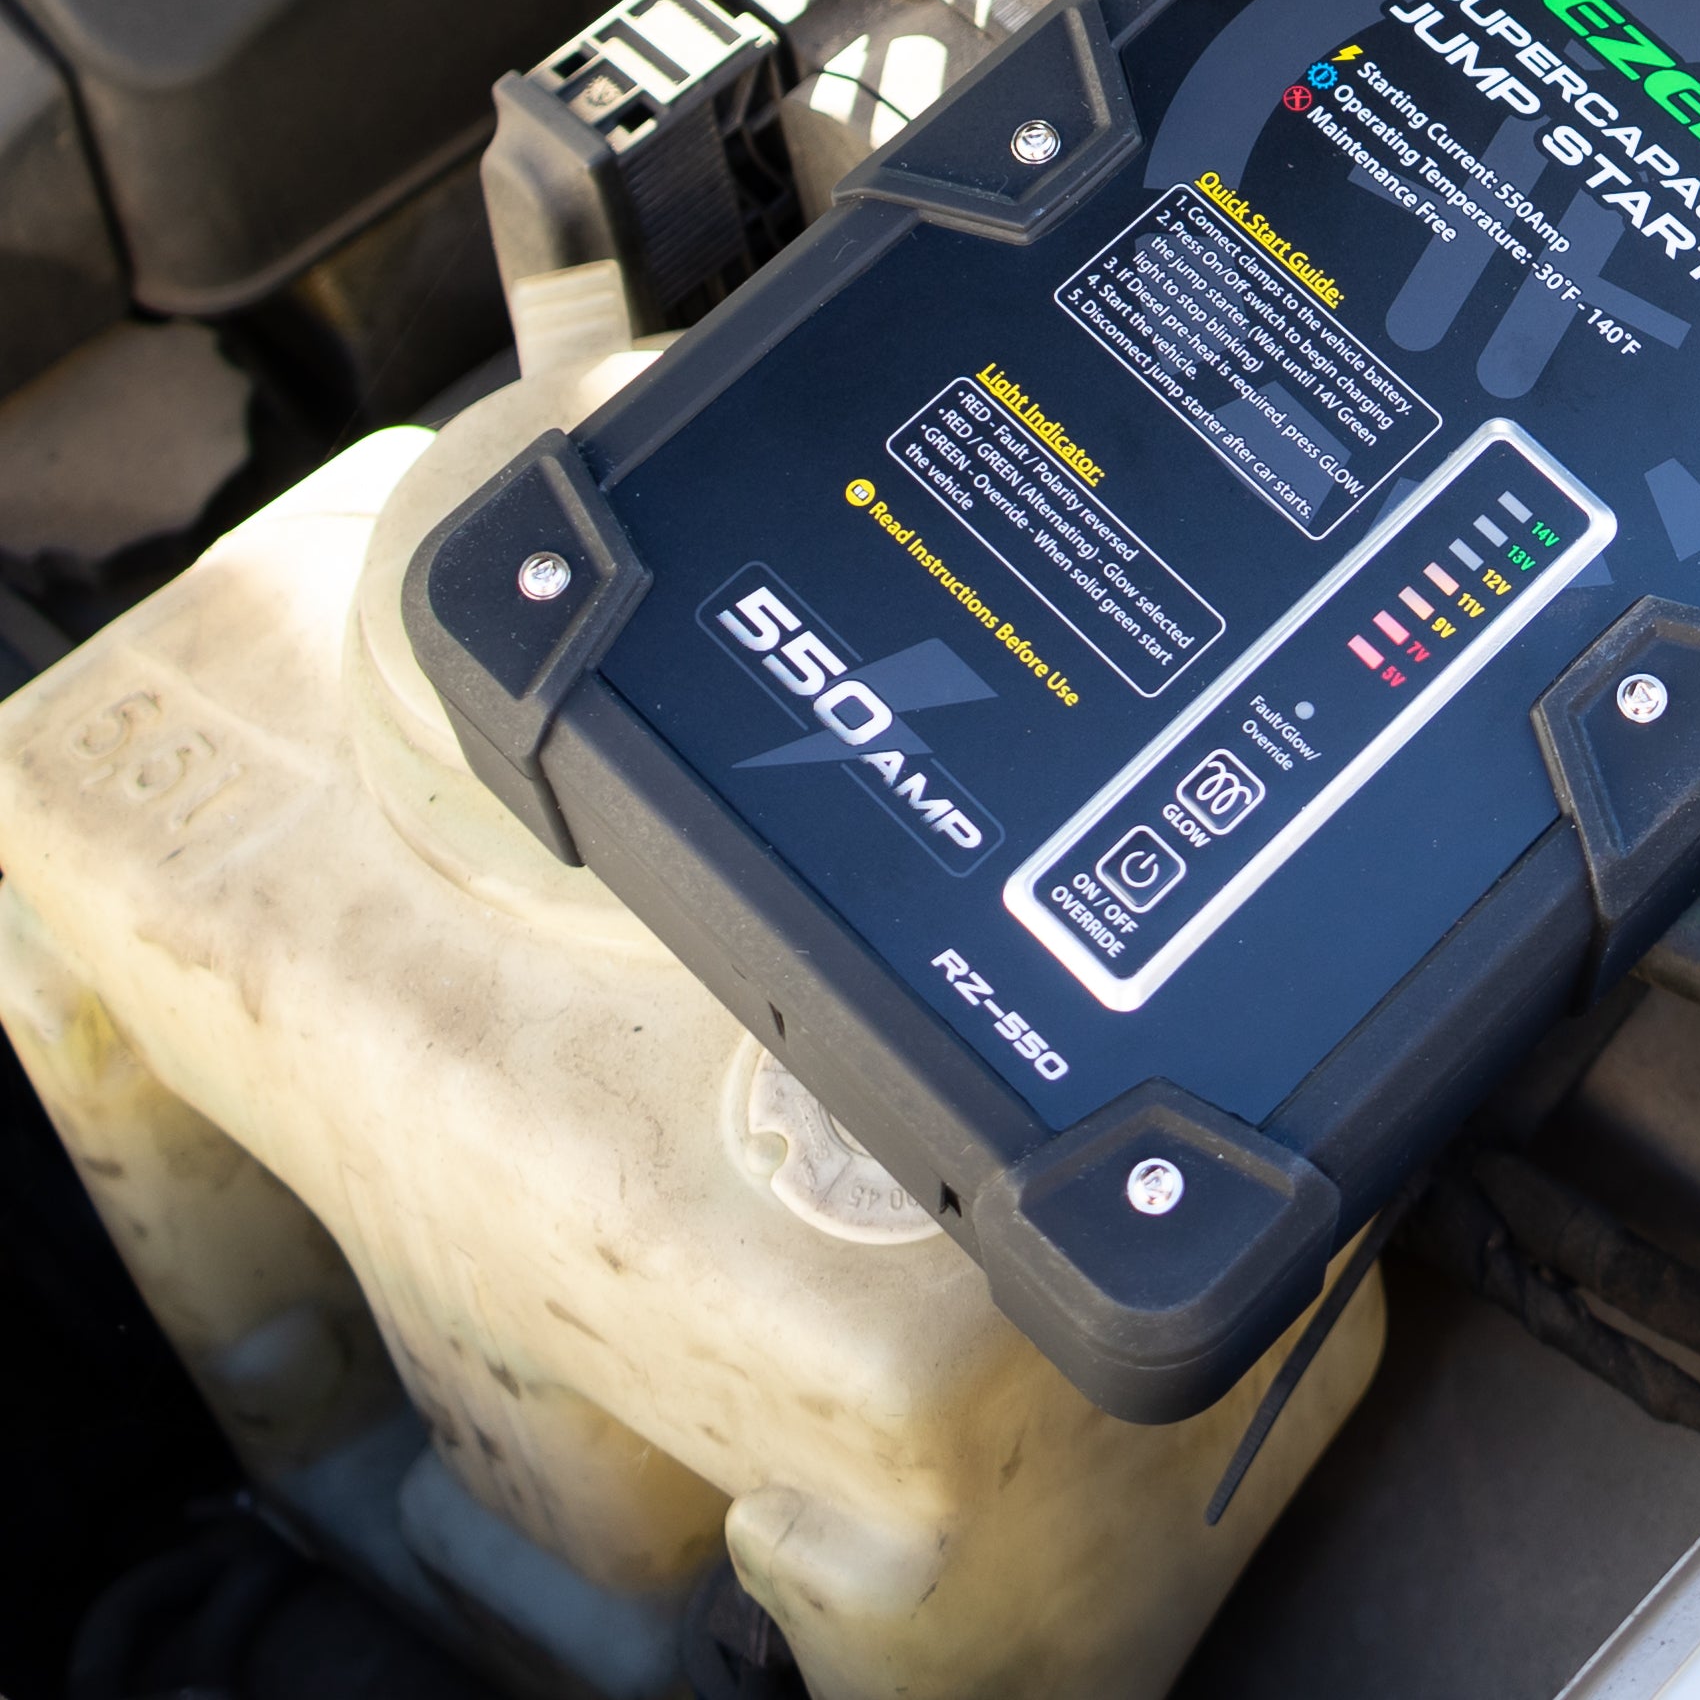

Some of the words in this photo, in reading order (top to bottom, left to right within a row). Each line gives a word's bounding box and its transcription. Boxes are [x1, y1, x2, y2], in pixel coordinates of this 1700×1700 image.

[1387, 1, 1542, 115] JUMP
[1305, 104, 1418, 209] Maintenance
[1413, 200, 1457, 243] Free
[1332, 83, 1422, 168] Operating
[1417, 155, 1533, 266] Temperature:
[1355, 60, 1430, 131] Starting
[1426, 121, 1499, 191] Current:
[1493, 182, 1571, 254] 550Amp
[1199, 171, 1251, 220] Quick
[1244, 212, 1292, 257] Start
[1287, 251, 1345, 306] Guide:
[1085, 273, 1102, 290] 4.
[1097, 283, 1133, 318] Start
[1127, 311, 1154, 338] the
[1150, 332, 1198, 382] vehicle.
[1131, 249, 1166, 285] light
[1160, 277, 1180, 297] to
[1174, 293, 1208, 323] stop
[1203, 315, 1265, 374] blinking)
[1149, 235, 1175, 261] the
[1166, 254, 1208, 291] jump
[1203, 287, 1251, 331] starter.
[1245, 324, 1286, 362] (Wait
[1280, 356, 1318, 389] until
[1311, 382, 1344, 410] 14V
[1336, 405, 1378, 447] Green
[1154, 209, 1171, 228] 2.
[1167, 220, 1205, 256] Press
[1201, 250, 1252, 295] On/Off
[1241, 290, 1287, 332] switch
[1283, 325, 1302, 345] to
[1297, 338, 1339, 380] begin
[1335, 375, 1395, 431] charging
[1174, 194, 1188, 212] 1.
[1186, 205, 1242, 259] Connect
[1237, 254, 1285, 298] clamps
[1281, 291, 1299, 311] to
[1296, 305, 1322, 332] the
[1318, 326, 1366, 372] vehicle
[1361, 364, 1413, 417] battery.
[979, 361, 1029, 411] Light
[1023, 402, 1106, 484] Indicator:
[1066, 287, 1084, 306] 5.
[1079, 298, 1153, 369] Disconnect
[1141, 361, 1185, 399] jump
[1179, 394, 1227, 436] starter
[1220, 432, 1257, 464] after
[1251, 461, 1278, 483] car
[1271, 479, 1313, 520] starts.
[1102, 255, 1119, 275] 3.
[1115, 266, 1135, 283] If
[1125, 276, 1172, 318] Diesel
[1160, 313, 1221, 367] pre-heat
[1215, 359, 1232, 377] is
[1226, 372, 1288, 430] required,
[1279, 423, 1322, 460] press
[1317, 453, 1365, 500] GLOW.
[904, 442, 931, 470] the
[926, 464, 974, 512] vehicle
[940, 408, 974, 439] RED
[976, 442, 1025, 488] GREEN
[1015, 481, 1100, 561] (Alternating)
[1102, 561, 1141, 599] Glow
[1133, 595, 1196, 650] selected
[959, 392, 992, 423] RED
[991, 423, 1030, 461] Fault
[1031, 460, 1084, 512] Polarity
[1077, 507, 1140, 563] reversed
[1530, 521, 1560, 548] 14V
[867, 500, 916, 545] Read
[906, 537, 1000, 630] Instructions
[993, 622, 1049, 678] Before
[1045, 670, 1079, 708] Use
[923, 426, 972, 472] GREEN
[972, 472, 1029, 530] Override
[1032, 528, 1073, 573] When
[1068, 567, 1109, 602] solid
[1096, 597, 1142, 638] green
[1136, 632, 1174, 667] start
[1456, 592, 1485, 619] 11V
[1480, 568, 1512, 596] 12V
[1506, 544, 1536, 572] 13V
[1380, 665, 1406, 688] 5V
[1405, 640, 1430, 663] 7V
[1430, 616, 1457, 639] 9V
[715, 585, 894, 747] 550
[864, 748, 984, 851] AMP
[1241, 718, 1294, 772] Override
[1248, 694, 1322, 762] Fault/Glow/
[1161, 802, 1212, 849] GLOW
[1049, 884, 1126, 959] OVERRIDE
[1071, 872, 1102, 902] ON
[1102, 903, 1139, 934] OFF
[929, 947, 1069, 1082] RZ-550
